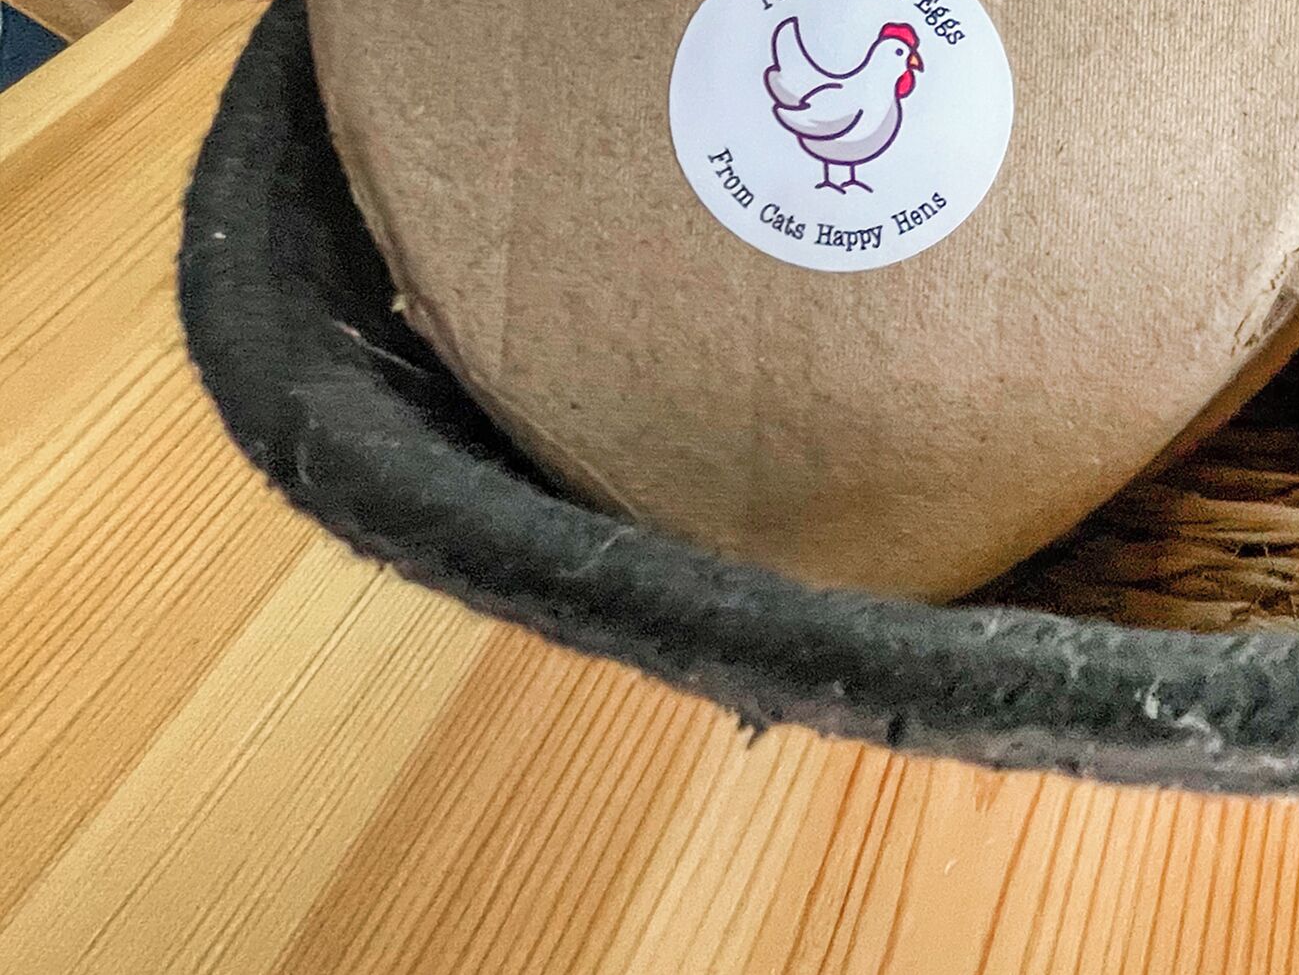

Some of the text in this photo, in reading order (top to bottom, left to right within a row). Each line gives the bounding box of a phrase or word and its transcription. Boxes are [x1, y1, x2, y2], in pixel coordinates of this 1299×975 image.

[708, 148, 947, 252] From Cats Happy Hens
